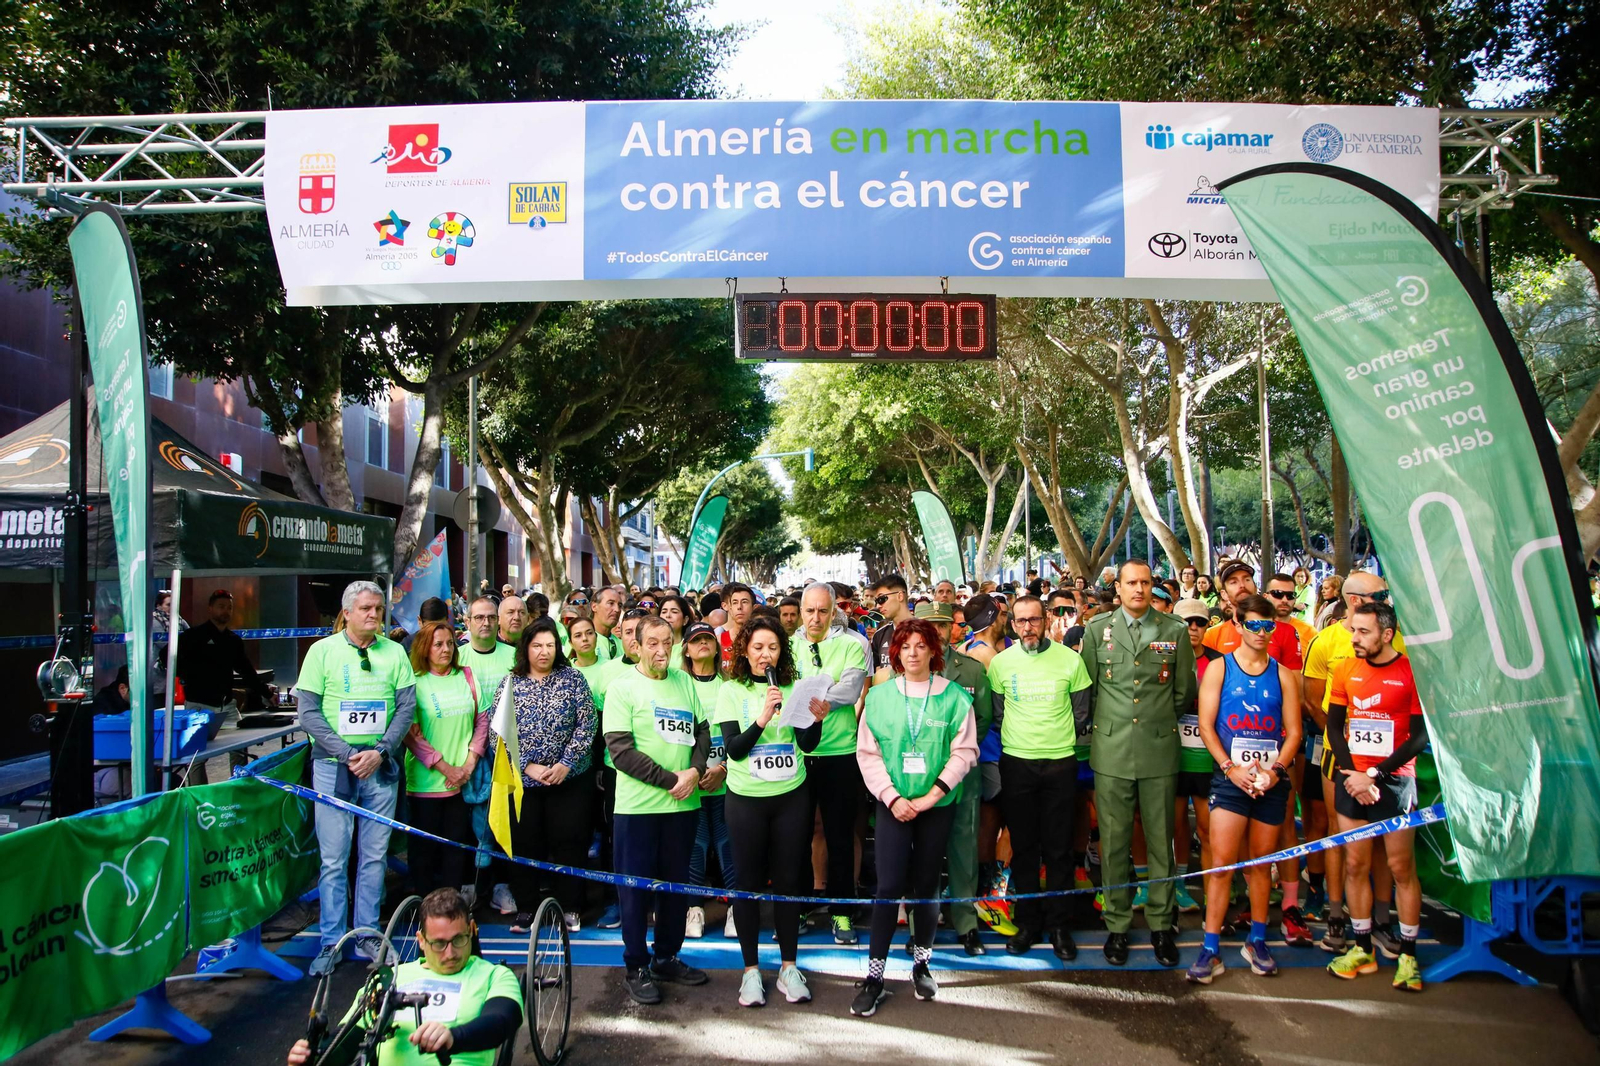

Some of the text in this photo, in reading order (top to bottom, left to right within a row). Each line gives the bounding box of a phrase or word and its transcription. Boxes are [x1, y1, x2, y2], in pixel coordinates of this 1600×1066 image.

[620, 118, 1090, 157] Almería en marcha
[1182, 127, 1274, 152] cajamar
[1344, 133, 1422, 144] UNIVERSIDAD
[1345, 143, 1423, 155] DE ALMERÍA
[385, 179, 433, 187] DEPORTES
[620, 171, 1029, 211] contra el cáncer
[515, 203, 560, 213] DE CABRAS
[279, 220, 350, 240] ALMERÍA
[1329, 221, 1367, 240] Ejido
[297, 240, 334, 250] CIUDAD
[1010, 234, 1111, 245] asociación española
[1193, 233, 1238, 246] Toyota
[398, 252, 418, 260] 2005
[1011, 246, 1091, 255] contra el cáncer
[1193, 248, 1245, 260] Alborán
[607, 249, 769, 266] #TodosContraElCáncer
[1011, 257, 1068, 267] en Almería
[6, 537, 65, 550] deportiv
[348, 711, 377, 724] 871
[1227, 713, 1276, 732] GALO
[658, 718, 692, 735] 1545
[1354, 730, 1383, 744] 543
[753, 755, 794, 770] 1600
[1241, 750, 1269, 763] 691
